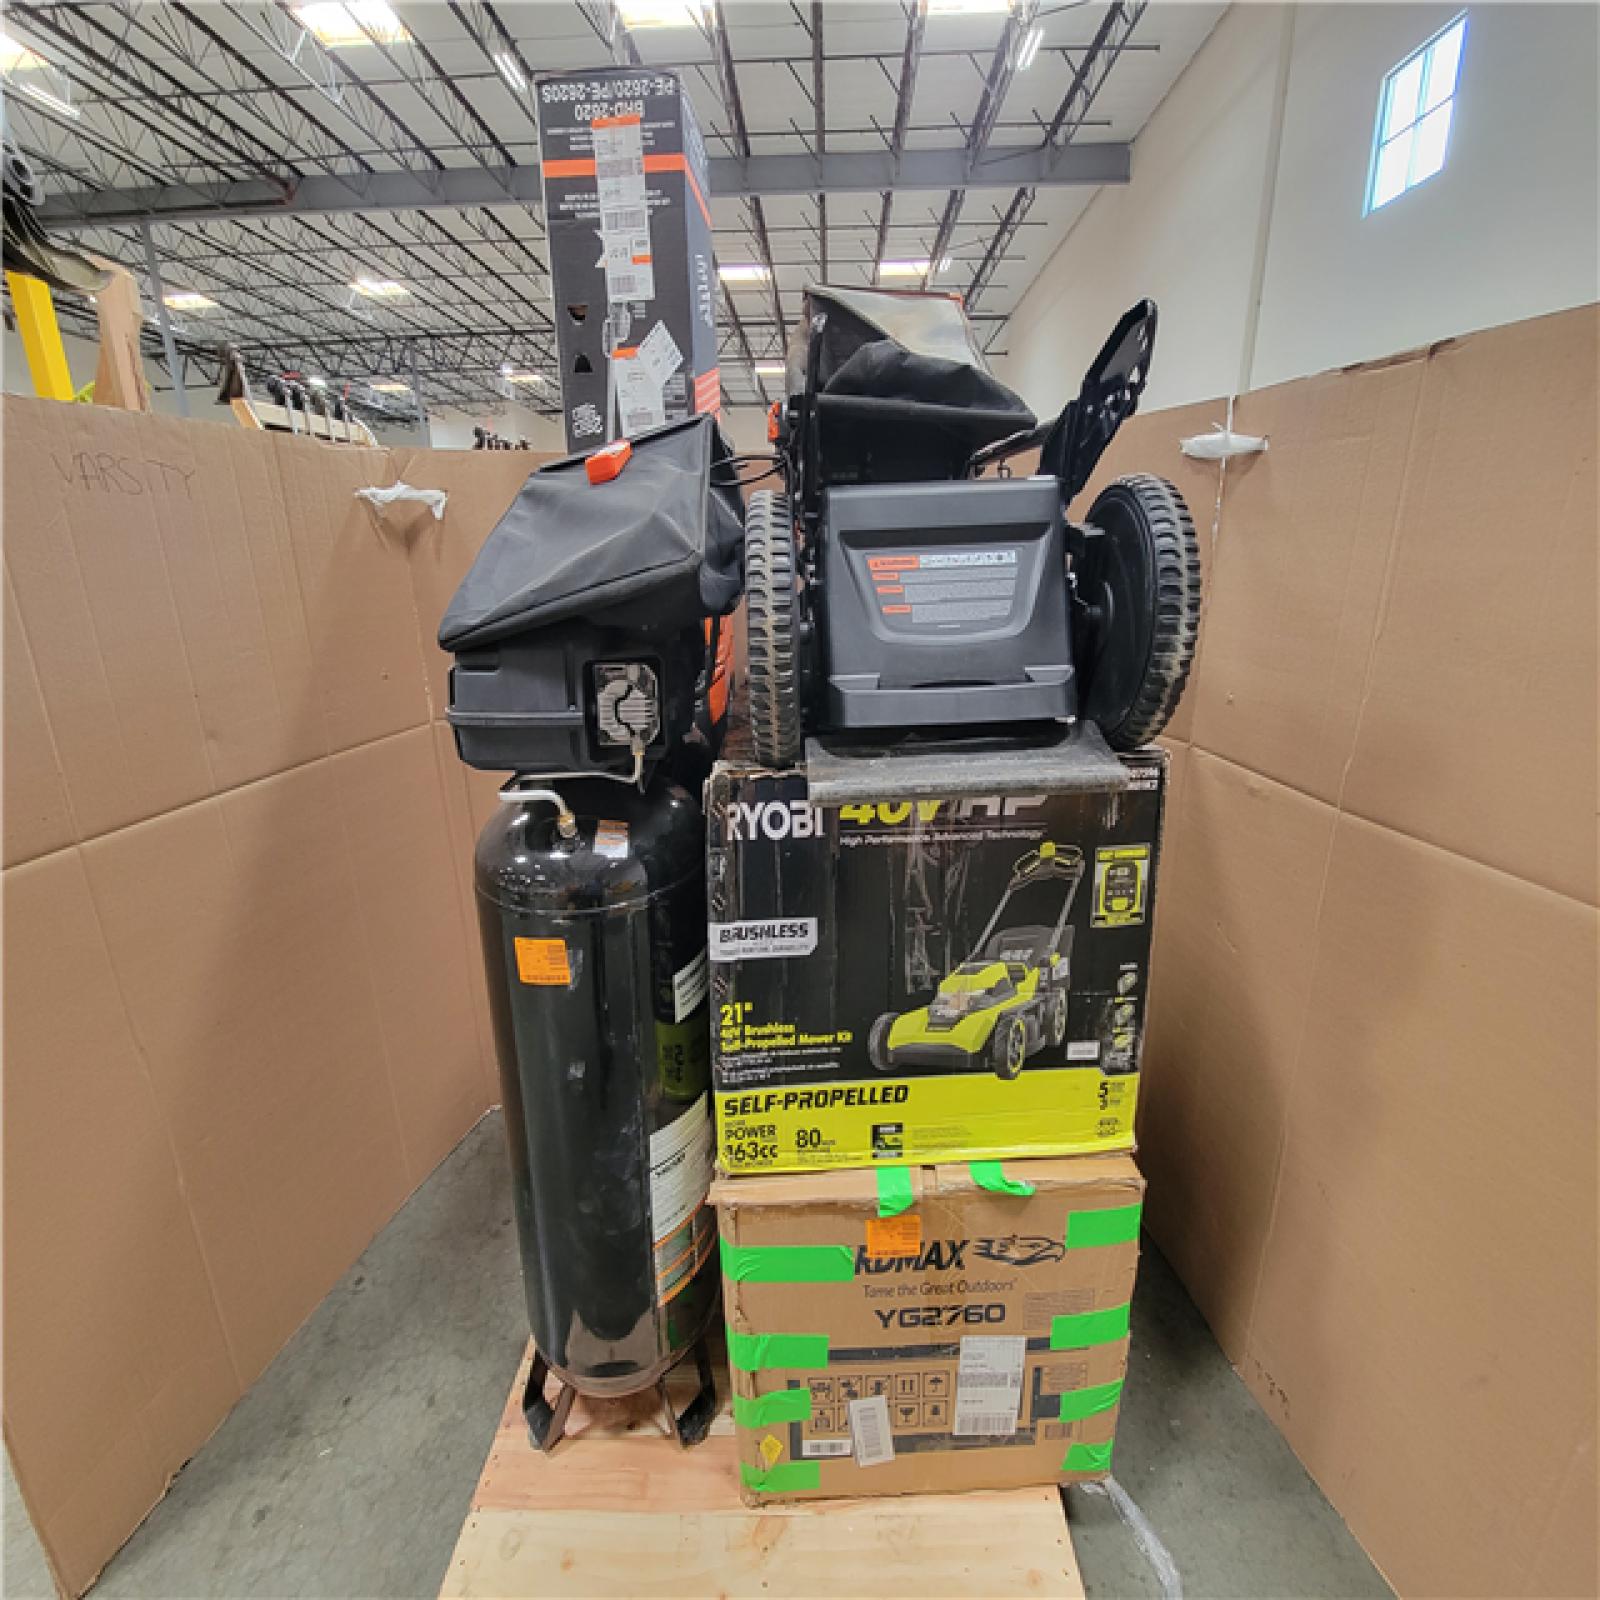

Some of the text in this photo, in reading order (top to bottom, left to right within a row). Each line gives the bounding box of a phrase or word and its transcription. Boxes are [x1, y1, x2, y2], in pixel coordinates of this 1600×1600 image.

[726, 800, 824, 841] RYOBI
[719, 922, 809, 944] BRUSHLESS
[724, 1085, 909, 1117] SELF-PROPELLED
[725, 1125, 776, 1141] POWER
[795, 1128, 822, 1148] 80
[725, 1141, 778, 1162] 163cc
[863, 1280, 1015, 1299] Tame the Great Outdoors
[874, 1303, 1006, 1329] YG2760
